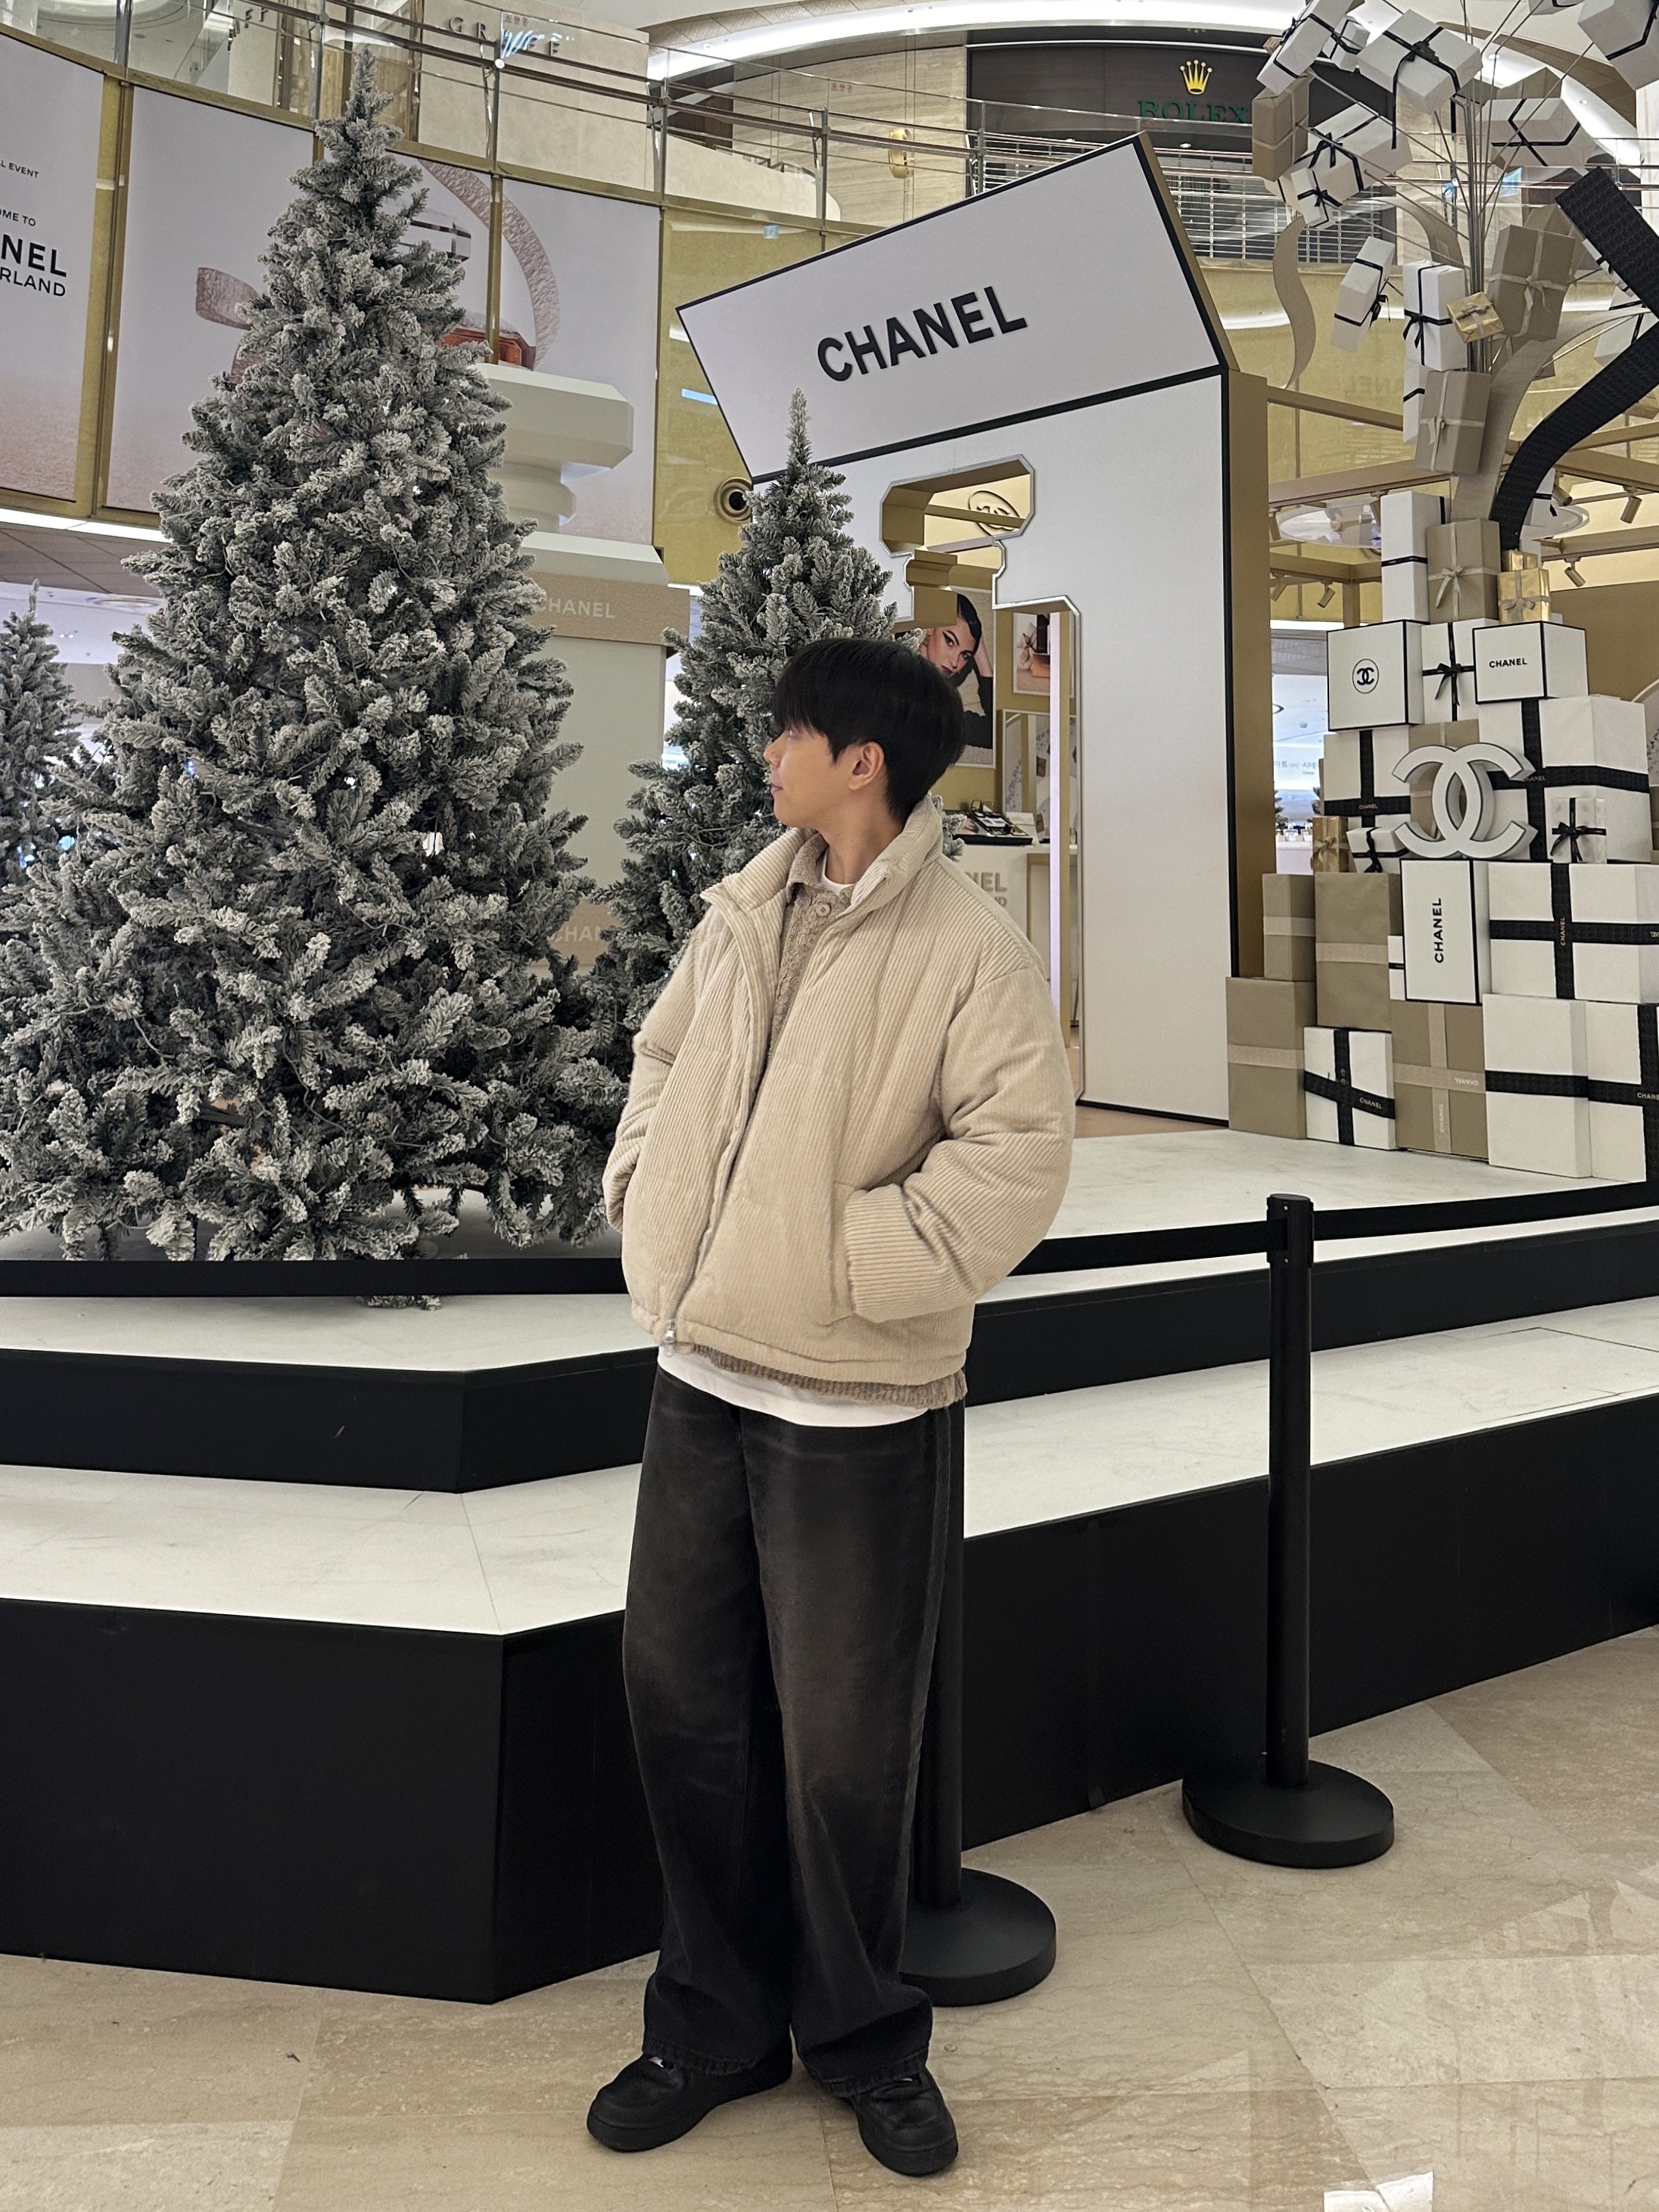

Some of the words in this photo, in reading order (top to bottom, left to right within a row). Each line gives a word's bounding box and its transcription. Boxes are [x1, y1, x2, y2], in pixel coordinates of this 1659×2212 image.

[1138, 99, 1249, 123] ROLEX
[8, 162, 39, 179] EVENT
[22, 215, 36, 226] TO
[1, 233, 67, 278] NEL
[817, 285, 1028, 381] CHANEL
[537, 597, 616, 619] HANEL
[1489, 657, 1528, 668] CHANEL
[1432, 898, 1444, 963] CHANEL
[1359, 1097, 1382, 1109] CHANEL
